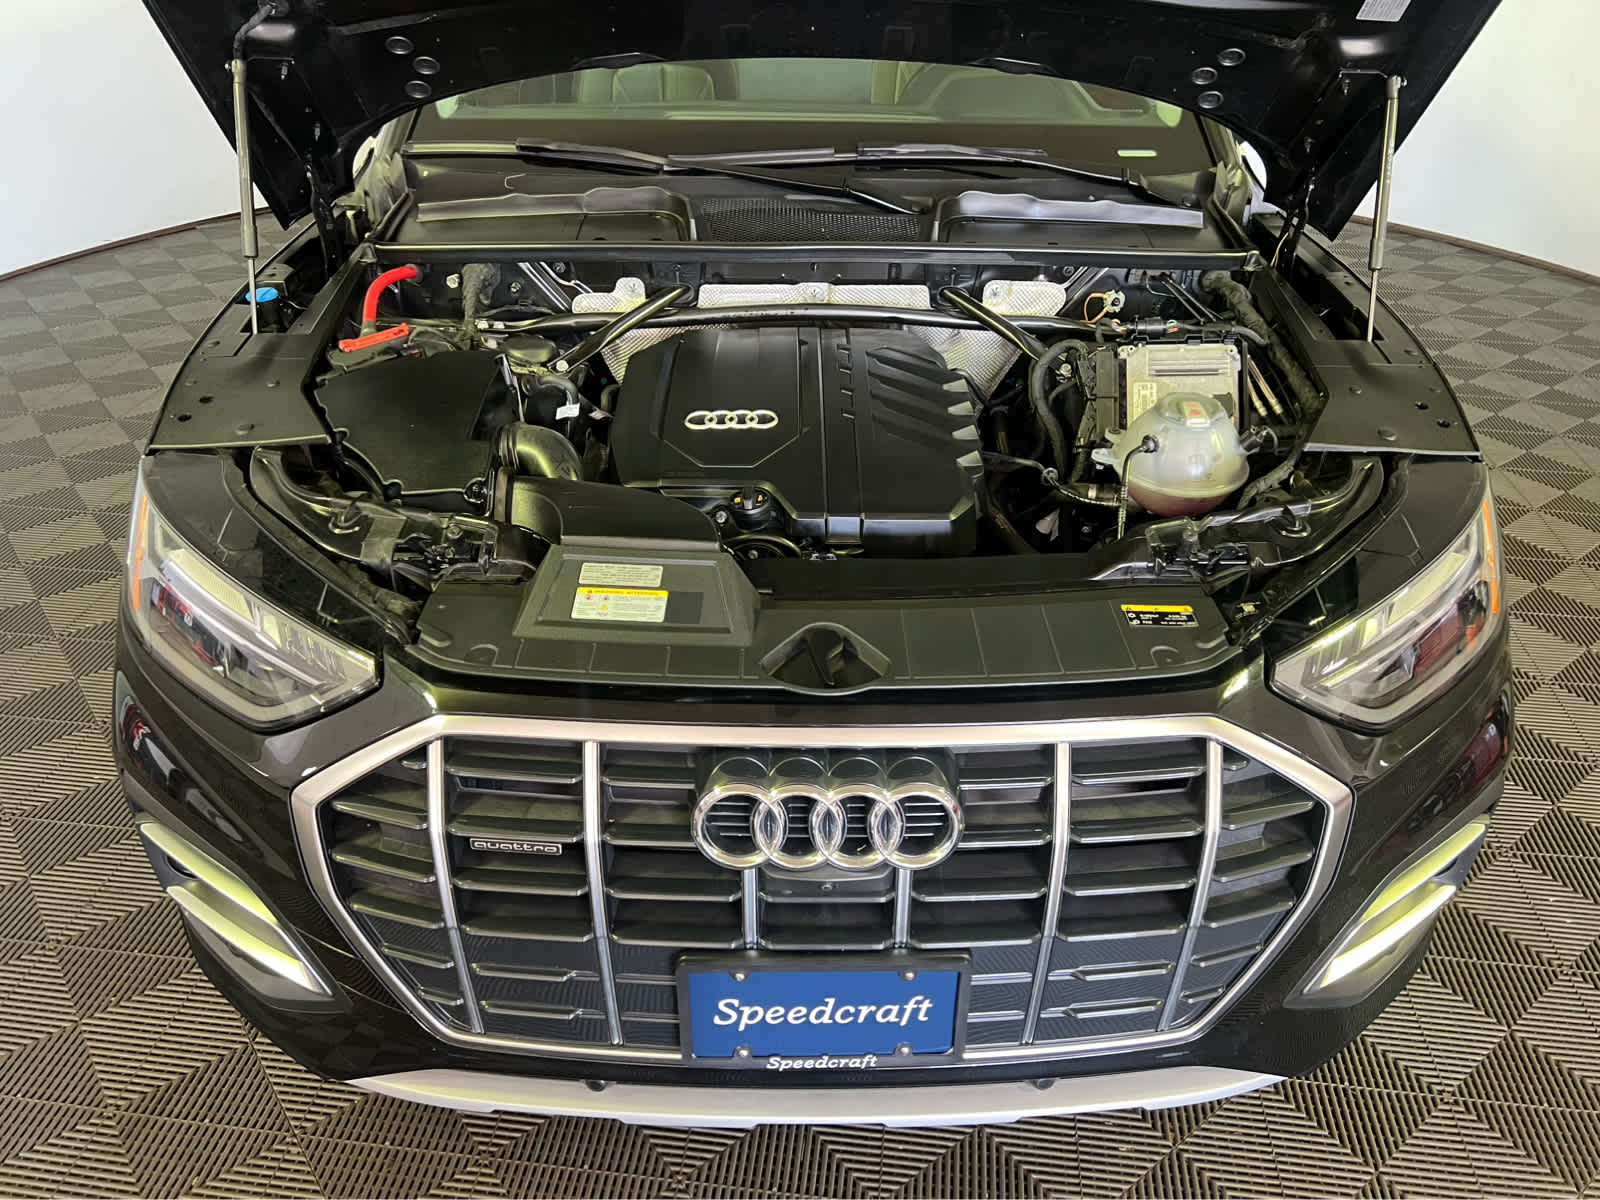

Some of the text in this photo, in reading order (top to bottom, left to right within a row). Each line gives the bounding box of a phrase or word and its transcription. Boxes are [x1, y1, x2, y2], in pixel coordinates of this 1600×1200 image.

[474, 841, 558, 853] quattro
[713, 995, 933, 1031] Speedcraft
[766, 1055, 878, 1071] Speedcraft
